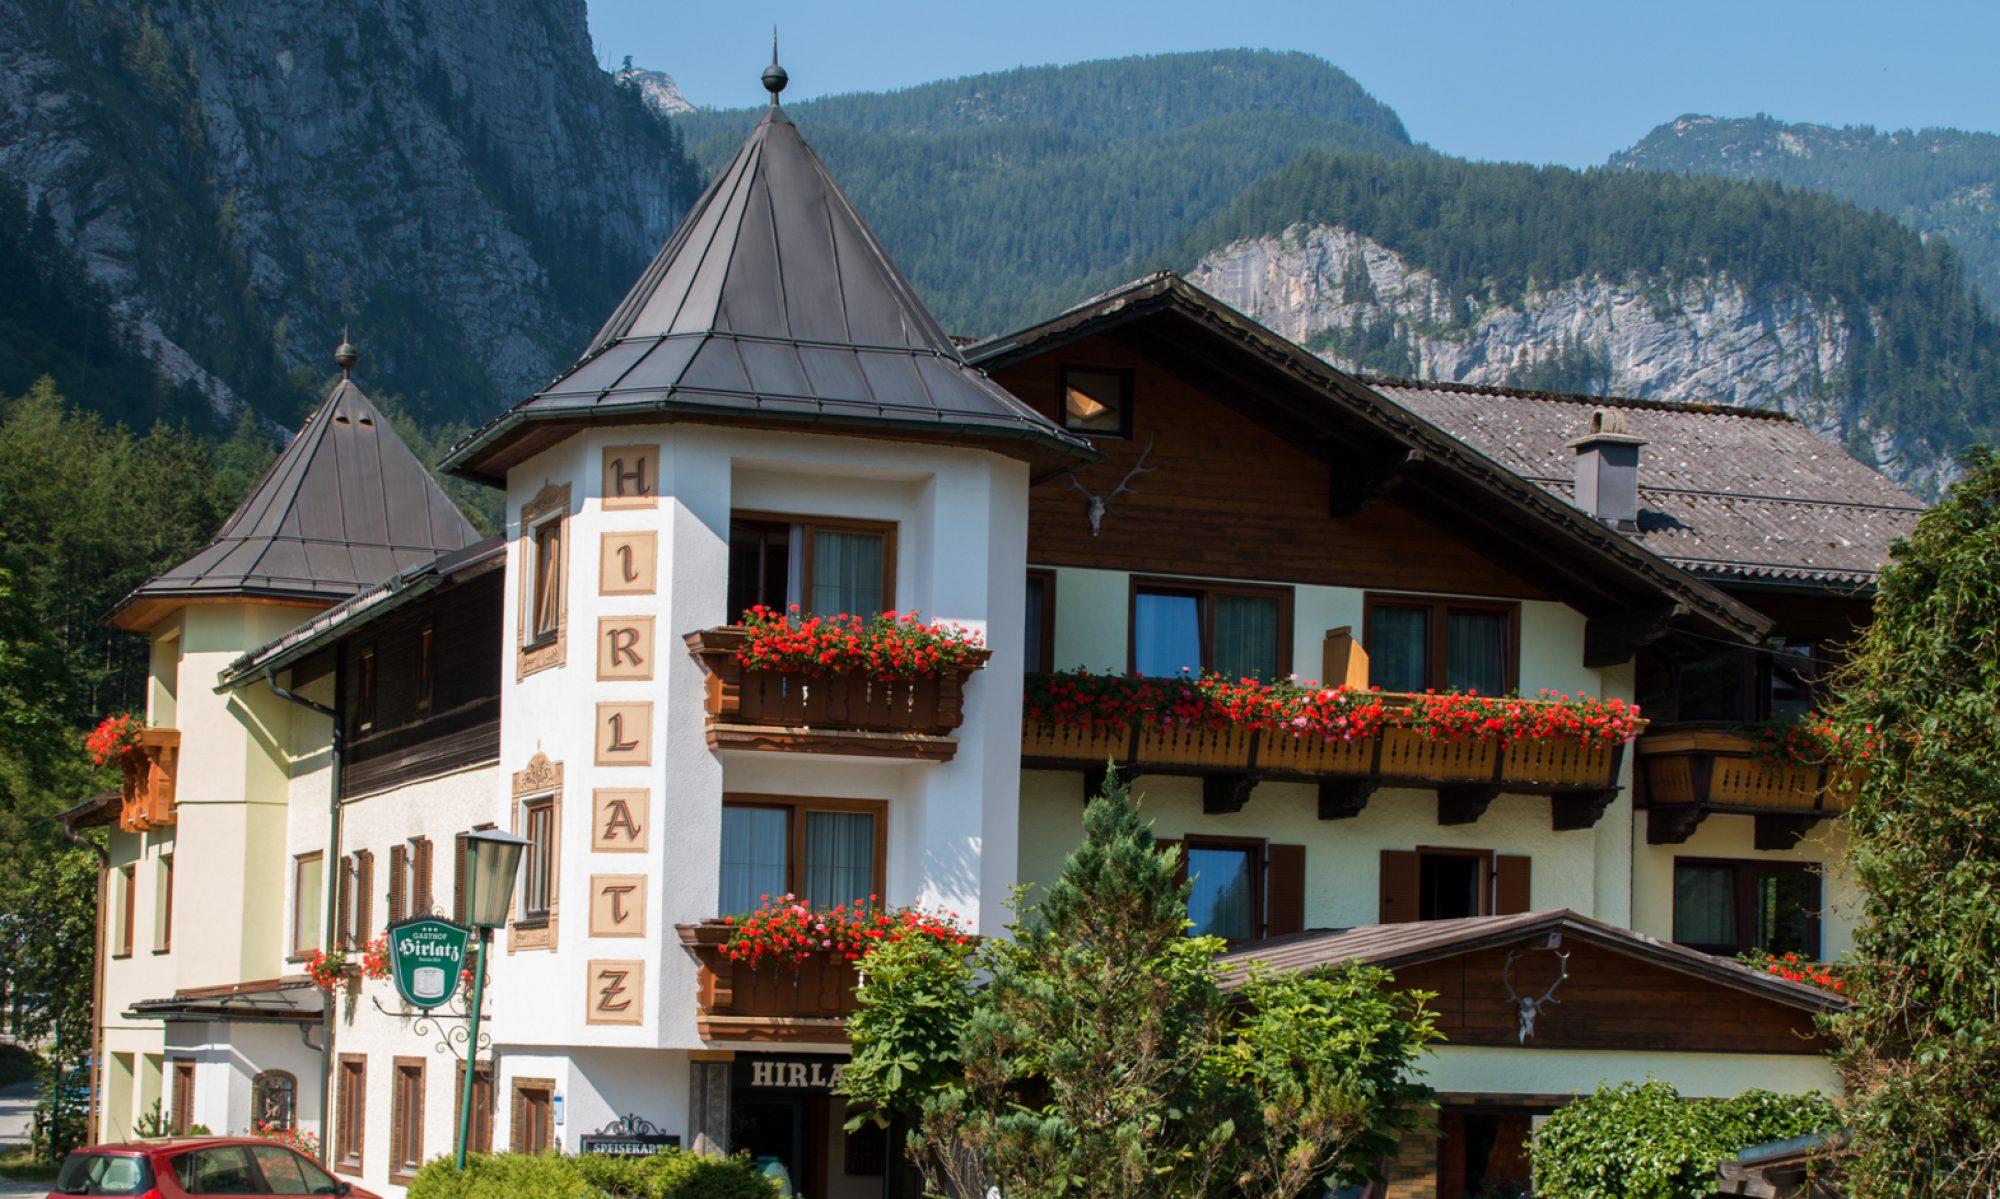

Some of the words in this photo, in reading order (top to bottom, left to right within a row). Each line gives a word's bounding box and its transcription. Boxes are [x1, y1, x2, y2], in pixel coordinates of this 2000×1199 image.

[597, 456, 650, 1012] HIRLATZ
[413, 932, 447, 940] GASTHOF
[399, 937, 460, 962] Hirlatz
